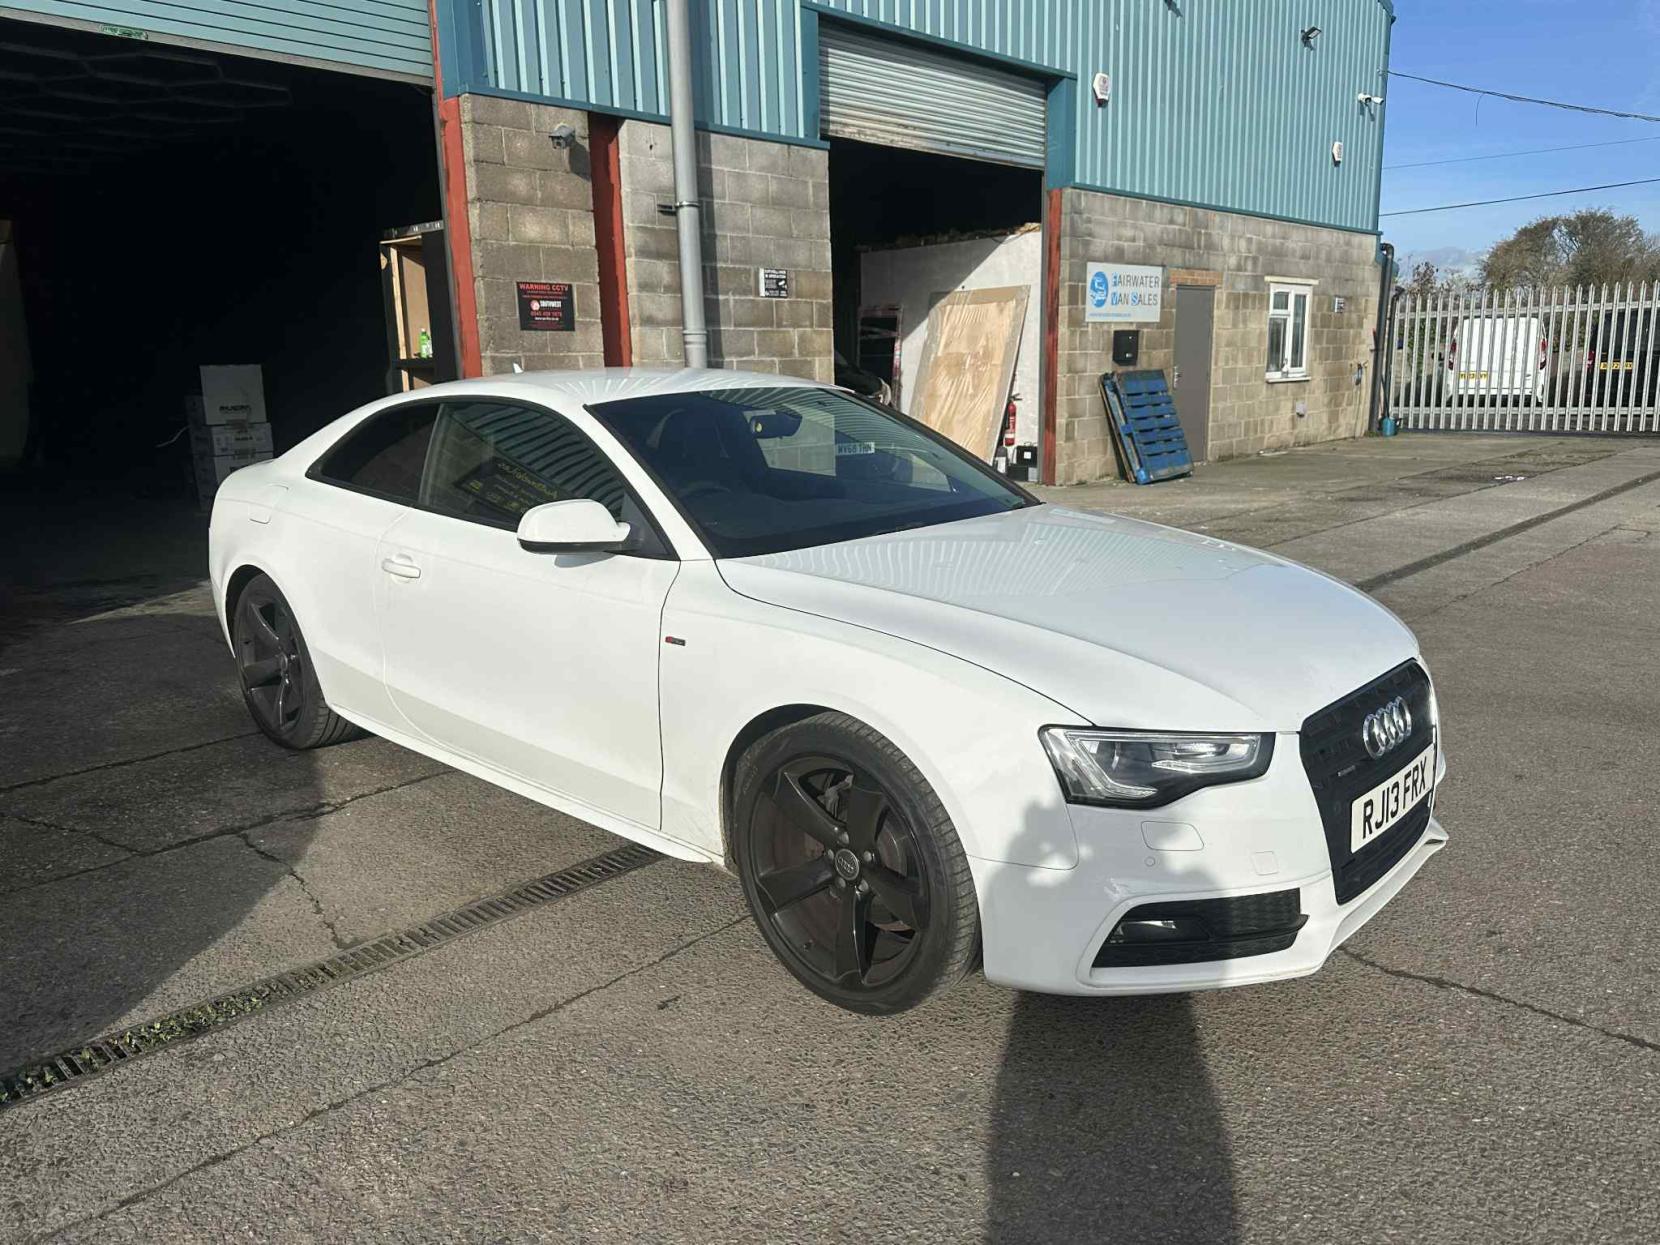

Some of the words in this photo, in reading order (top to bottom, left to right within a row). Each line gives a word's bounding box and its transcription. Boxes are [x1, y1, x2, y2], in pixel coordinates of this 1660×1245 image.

[519, 283, 550, 291] WARNING
[552, 284, 569, 292] CCTV
[1111, 271, 1160, 289] FAIRWATER
[1111, 291, 1129, 306] VAN
[1131, 292, 1158, 307] SALES
[1362, 781, 1400, 839] RJ13
[1402, 756, 1428, 810] FRX
